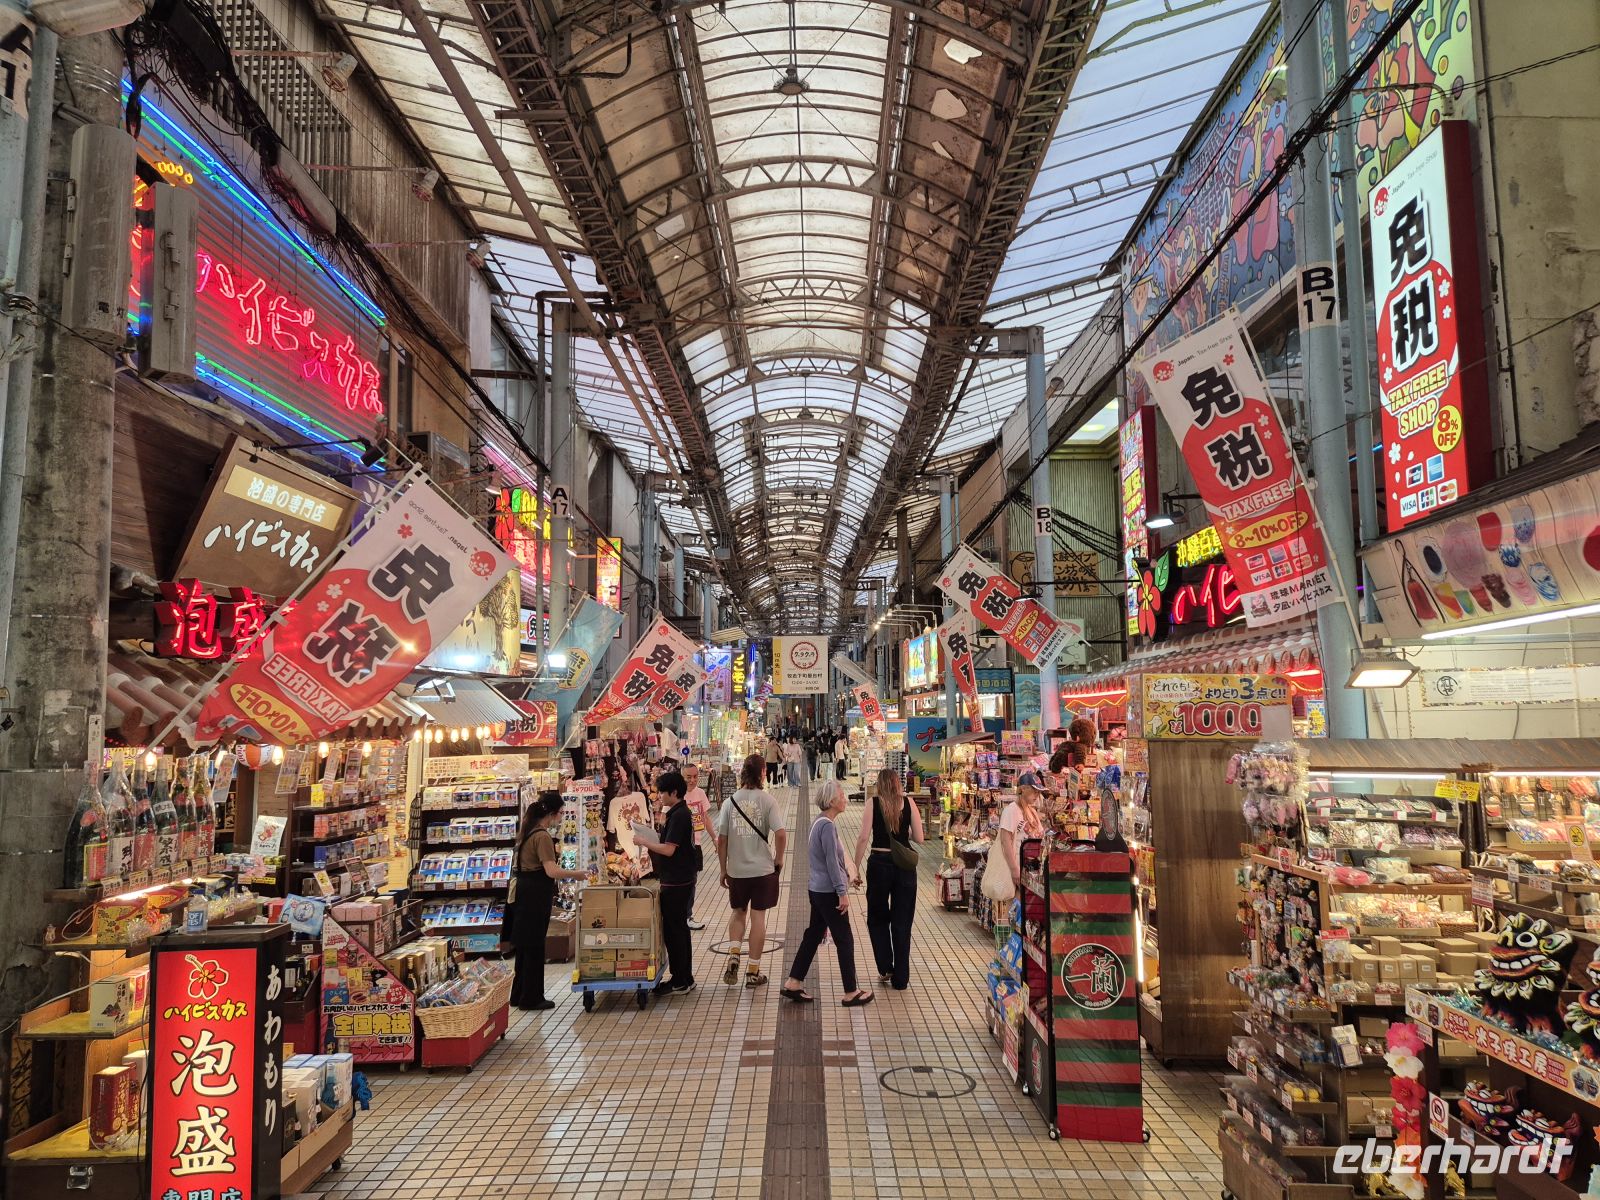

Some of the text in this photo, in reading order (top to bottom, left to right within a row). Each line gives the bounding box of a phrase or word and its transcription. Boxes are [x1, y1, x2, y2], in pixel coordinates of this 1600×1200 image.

[1303, 267, 1334, 295] B
[1389, 194, 1436, 366] 免税
[1303, 297, 1336, 322] 17
[1389, 364, 1447, 413] TAX FREE
[1181, 366, 1269, 486] 免税
[1400, 398, 1438, 435] SHOP
[1437, 432, 1457, 447] OFF
[246, 477, 328, 523] 泡盛の専門店
[552, 487, 568, 500] A
[552, 502, 568, 515] 17
[1222, 483, 1293, 521] TAX FREE
[1401, 502, 1417, 513] VISA
[1036, 508, 1050, 519] B
[1037, 521, 1052, 533] 18
[204, 519, 320, 574] ハイビスカス
[1253, 572, 1271, 582] VISA
[957, 570, 1015, 620] 免税
[624, 643, 675, 700] 免税
[860, 691, 875, 714] 免税
[1065, 953, 1120, 998] 一蘭
[163, 999, 249, 1022] ハイビスカス
[334, 1012, 412, 1037] 全国発送
[263, 963, 283, 1137] あわもり
[170, 1029, 240, 1177] 泡盛
